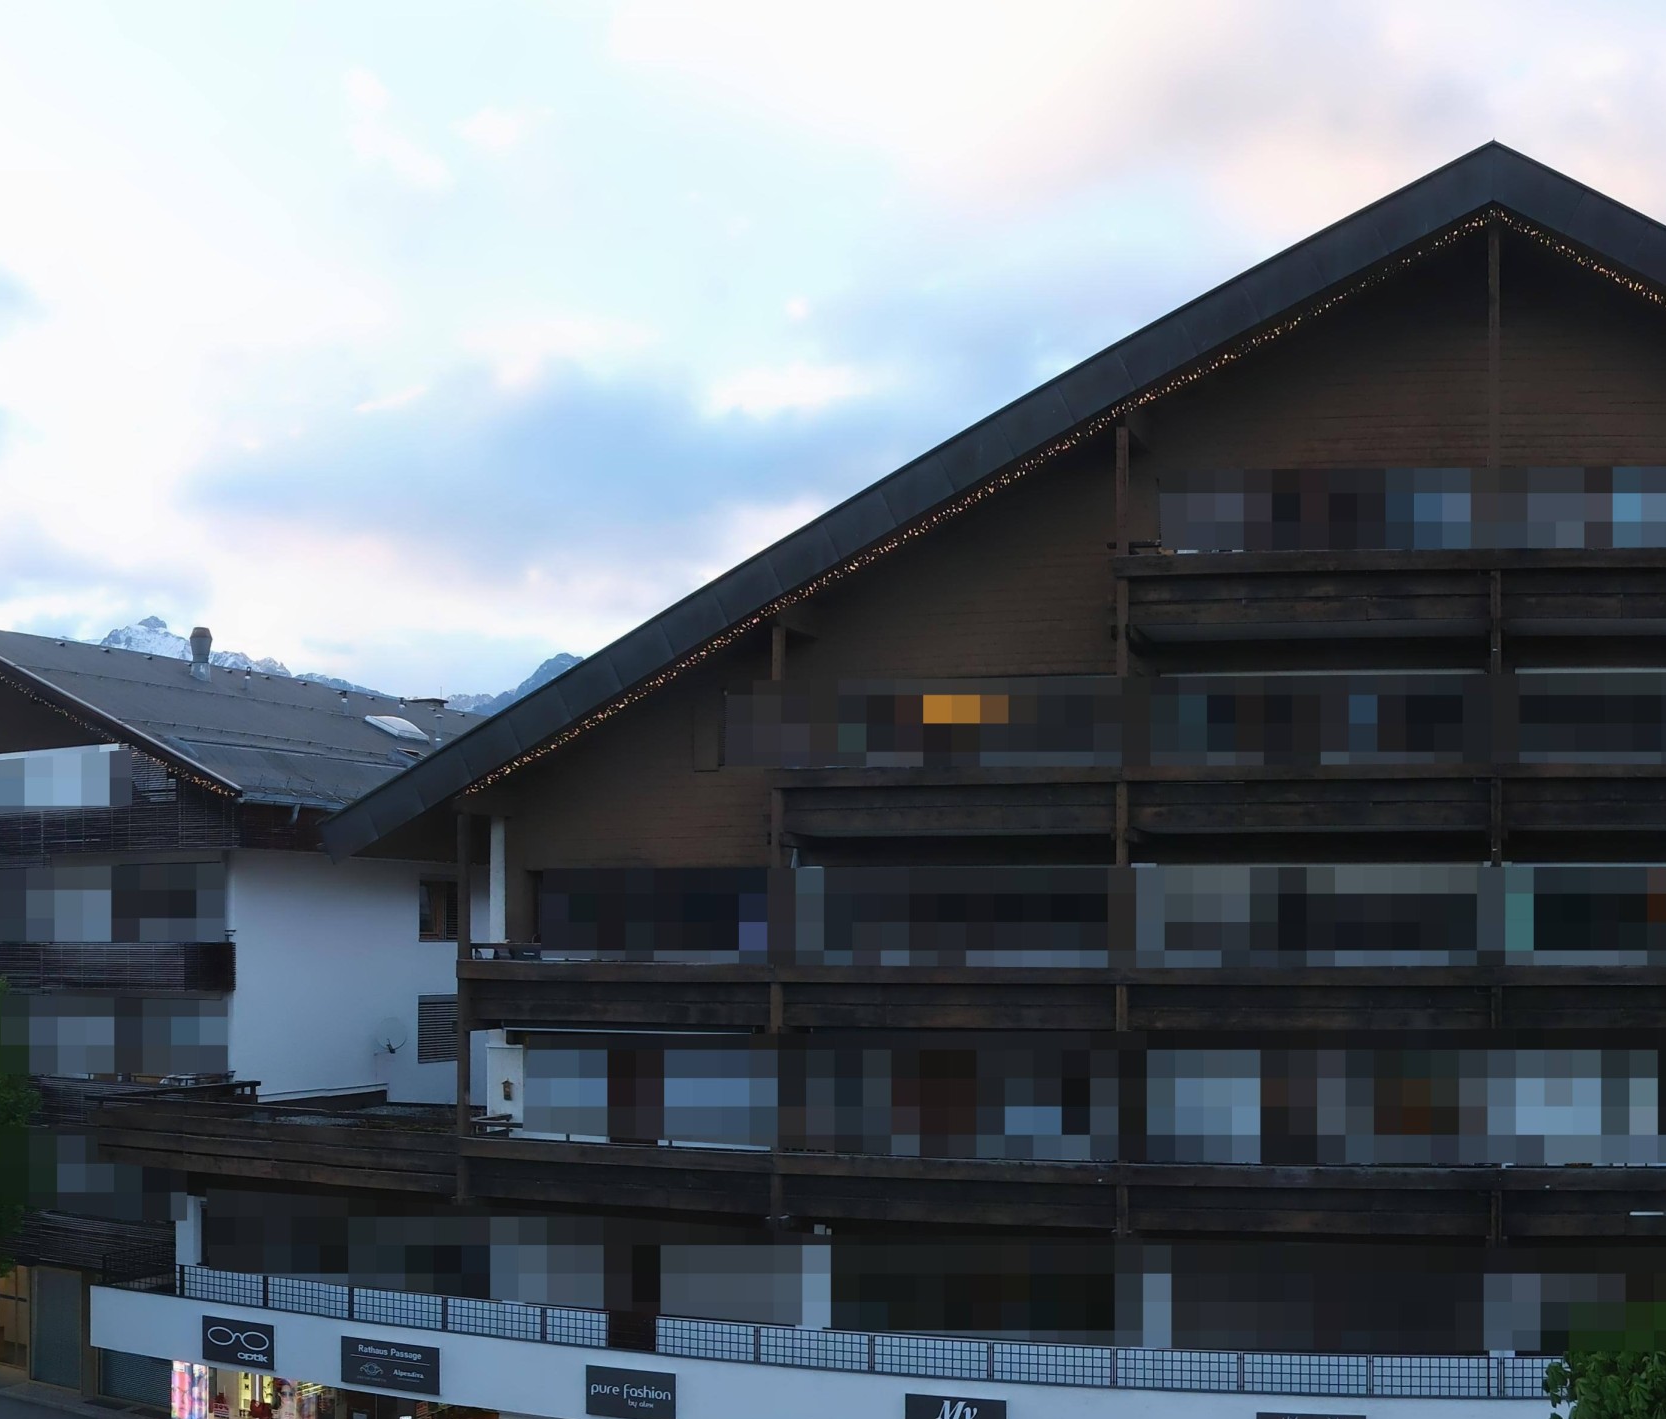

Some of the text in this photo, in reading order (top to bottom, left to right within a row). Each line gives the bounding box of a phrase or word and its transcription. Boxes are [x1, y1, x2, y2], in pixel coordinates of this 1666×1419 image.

[237, 1351, 268, 1363] optik
[358, 1344, 422, 1360] Rathaus Passage
[591, 1383, 671, 1400] pure fashion
[628, 1399, 654, 1409] by alex
